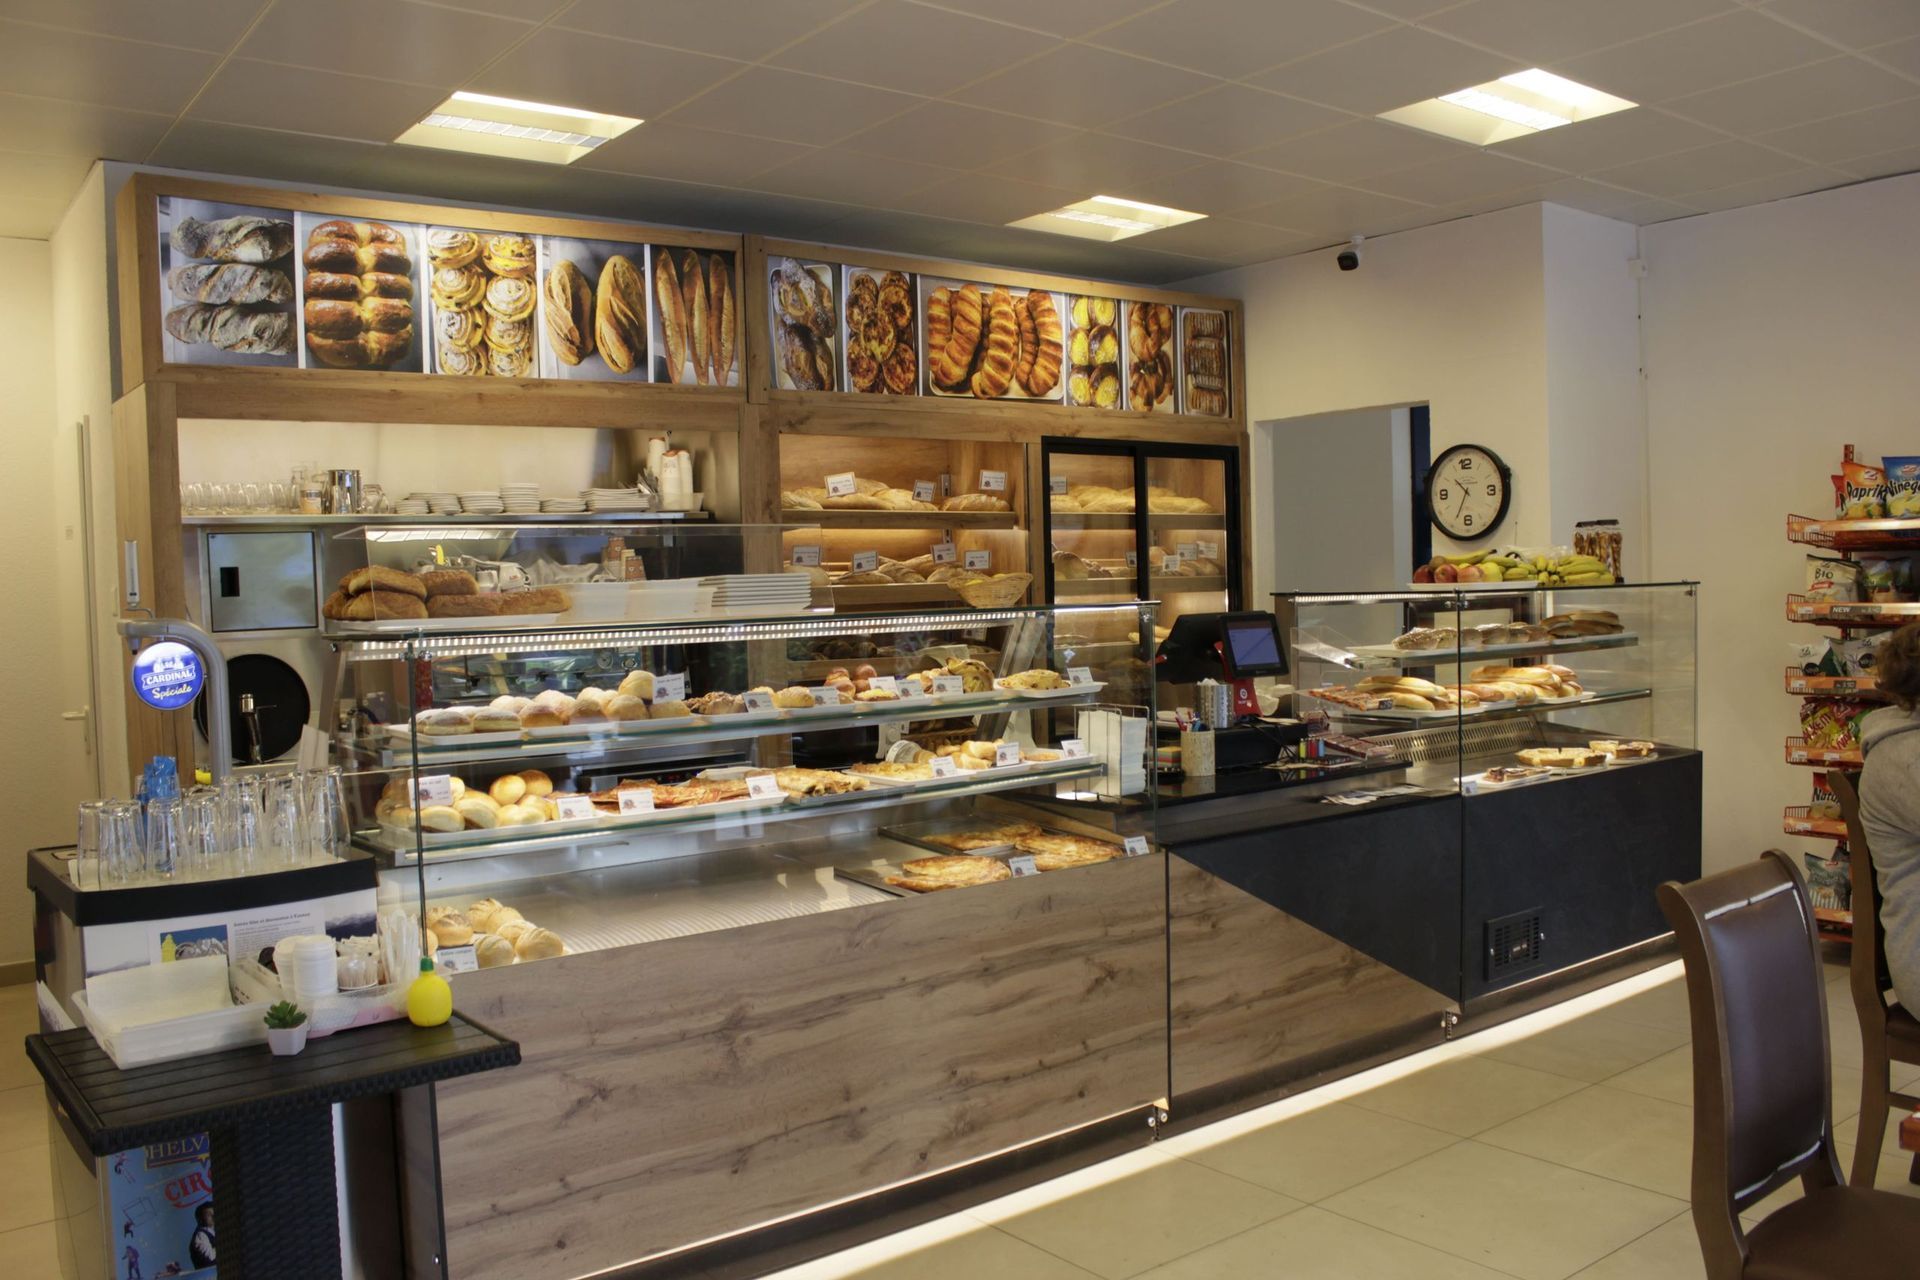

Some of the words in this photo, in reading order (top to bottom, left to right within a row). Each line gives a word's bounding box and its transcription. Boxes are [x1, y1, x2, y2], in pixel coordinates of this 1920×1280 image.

[1458, 458, 1473, 470] 12
[1439, 489, 1449, 501] 9
[1486, 484, 1496, 496] 3
[1846, 481, 1886, 502] Paprik
[1887, 480, 1920, 497] Vineg
[1463, 514, 1473, 526] 6
[1832, 606, 1851, 614] NEW
[146, 670, 192, 684] CARDINAL
[152, 684, 192, 700] Spéciale
[149, 1136, 209, 1159] HELV
